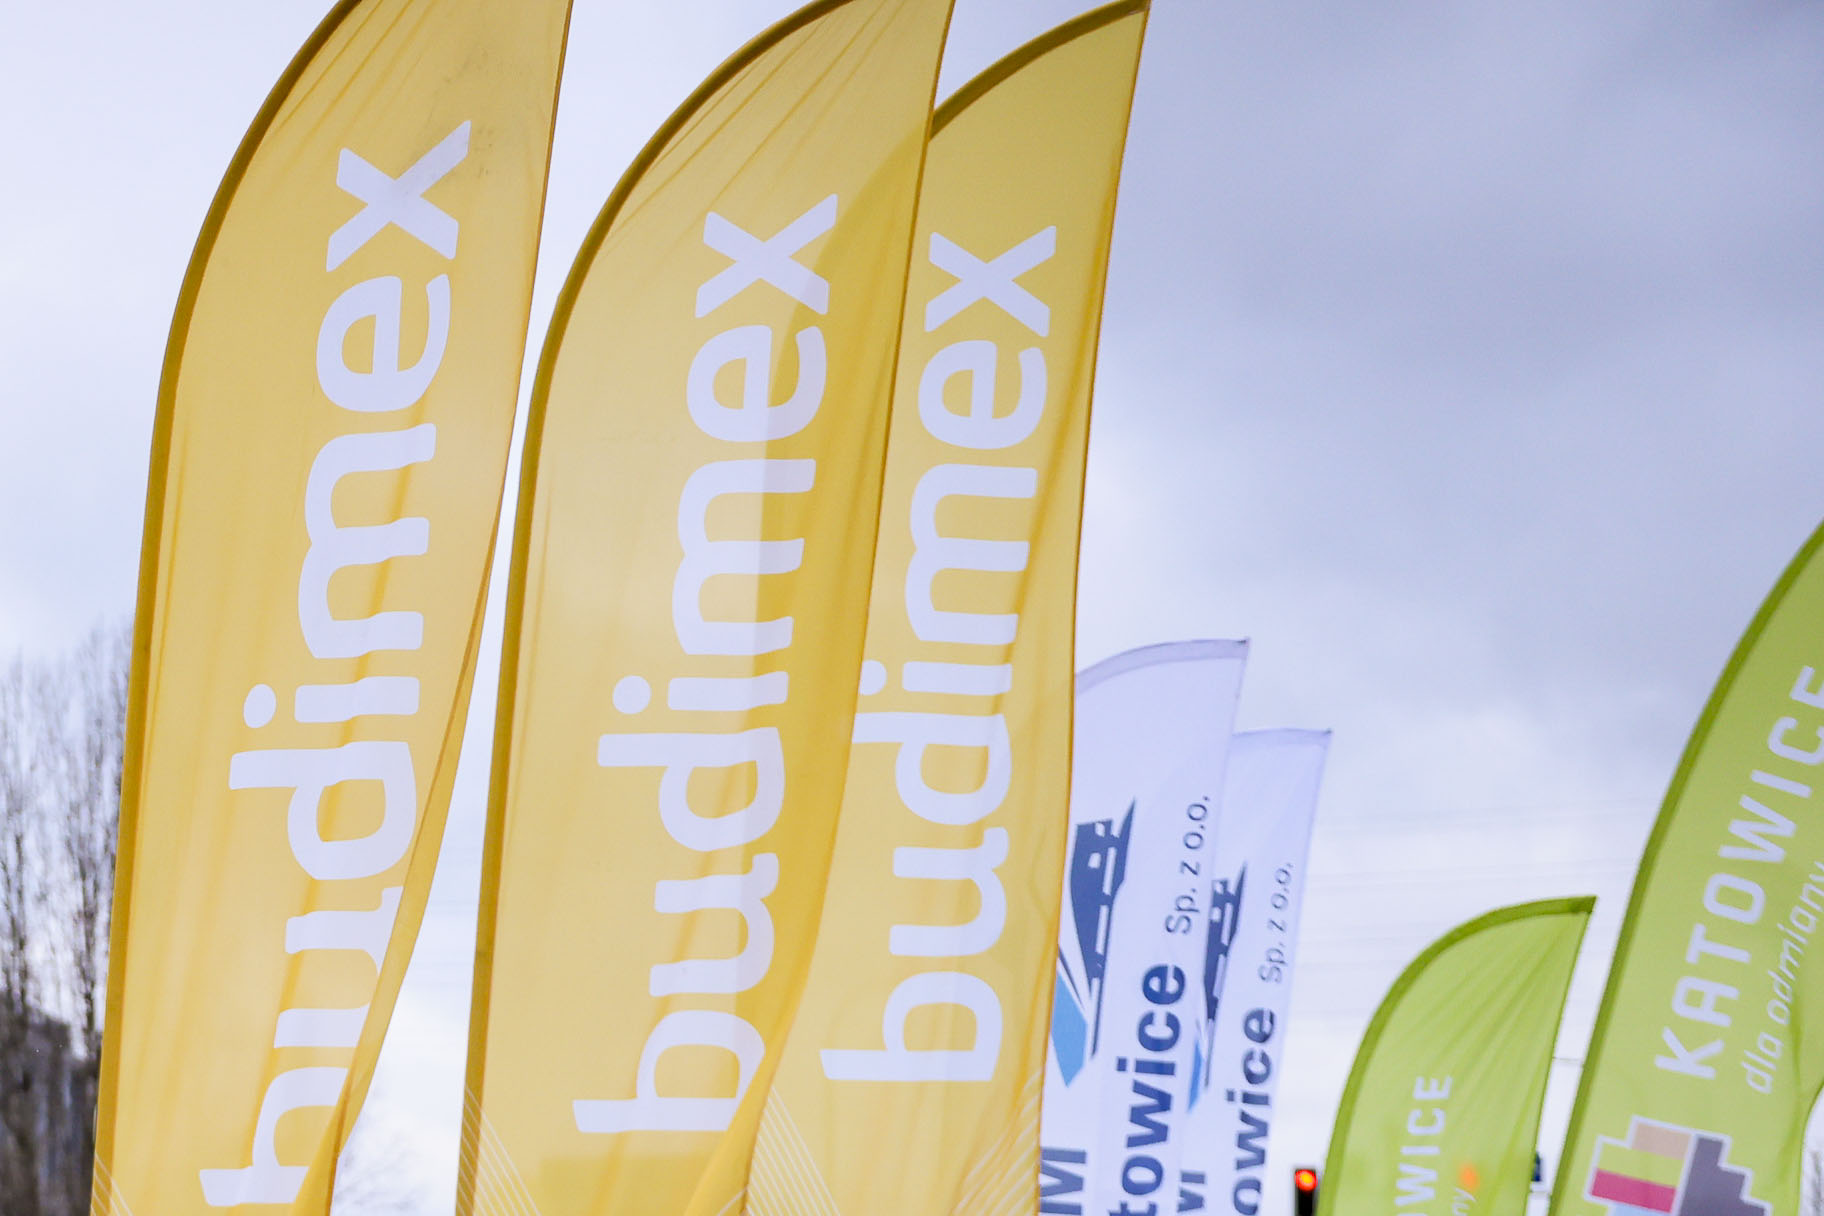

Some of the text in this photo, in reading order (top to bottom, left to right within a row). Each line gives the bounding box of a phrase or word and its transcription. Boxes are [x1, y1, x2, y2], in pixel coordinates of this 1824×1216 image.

[573, 193, 839, 1133] budimex
[820, 225, 1057, 1081] budimex
[1183, 796, 1210, 850] o.o.
[1179, 860, 1201, 876] z
[1165, 887, 1200, 934] Sp.
[1741, 1032, 1784, 1094] dla
